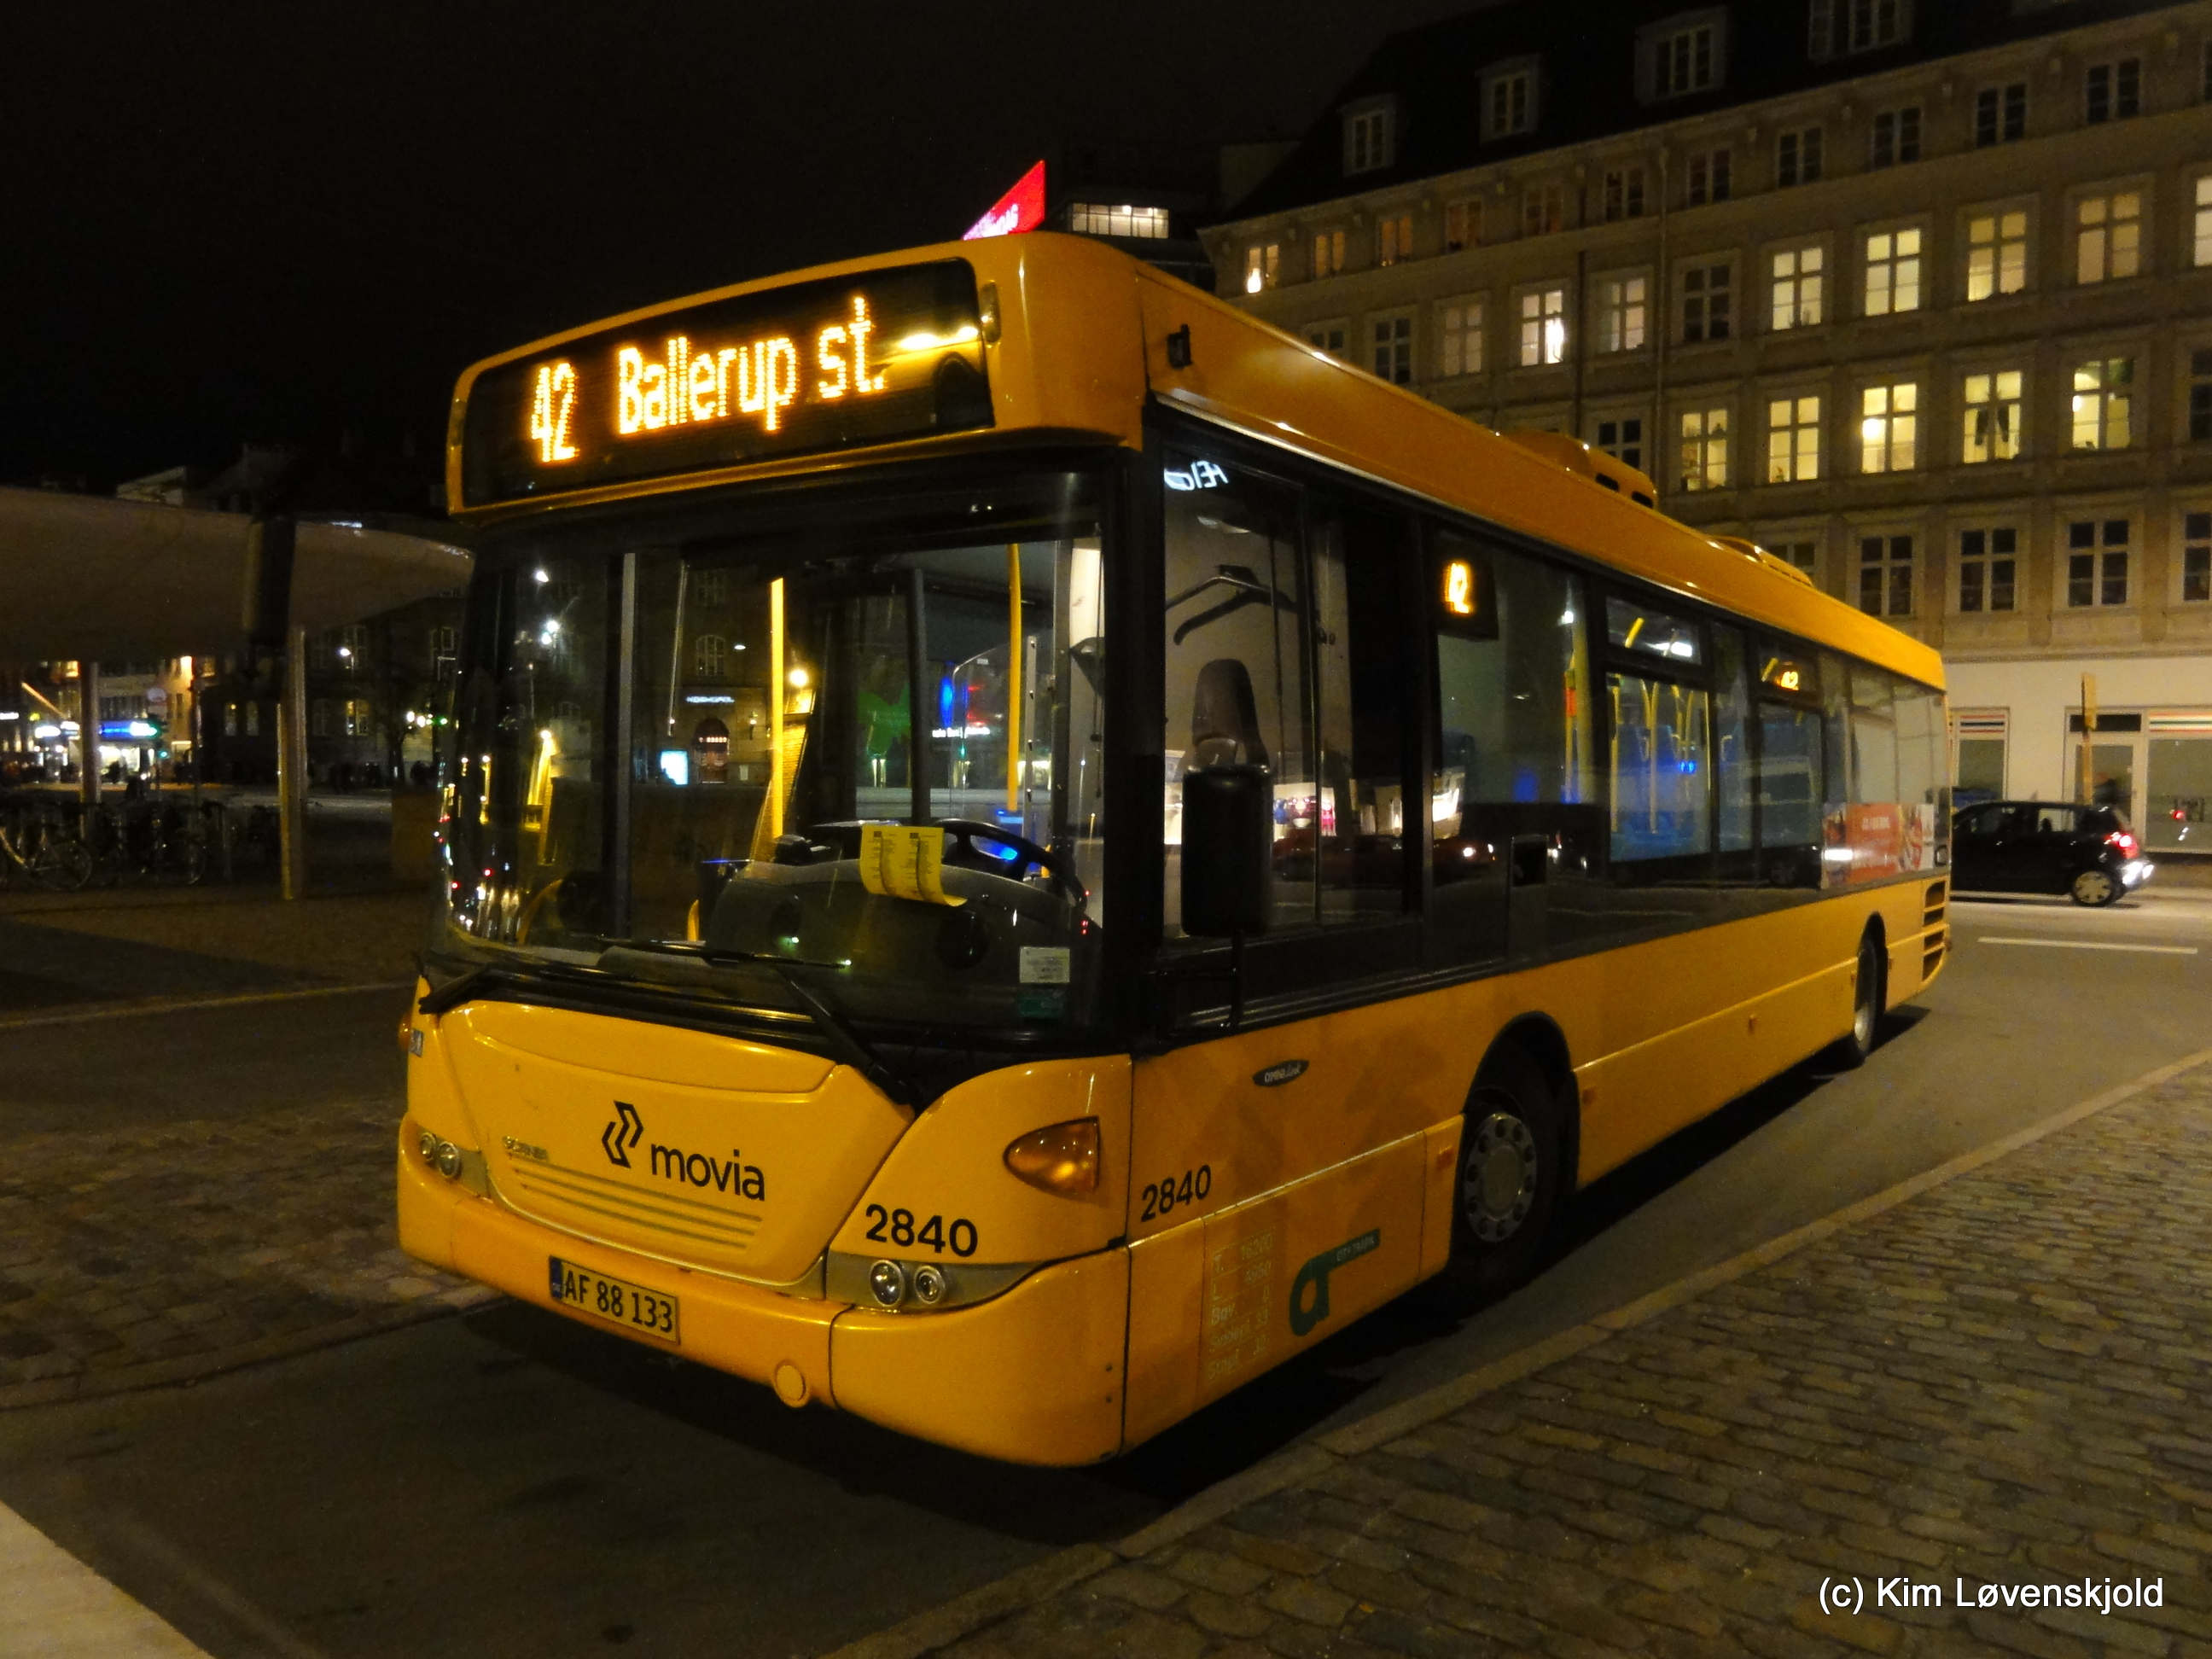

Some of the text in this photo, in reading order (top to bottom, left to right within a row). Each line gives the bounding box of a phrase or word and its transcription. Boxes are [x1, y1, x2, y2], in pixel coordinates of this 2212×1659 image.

[529, 295, 888, 463] 42 Ballerup st.
[650, 1142, 765, 1202] movia
[1140, 1163, 1212, 1223] 2840
[864, 1203, 979, 1257] 2840
[565, 1270, 673, 1333] AF 88 133
